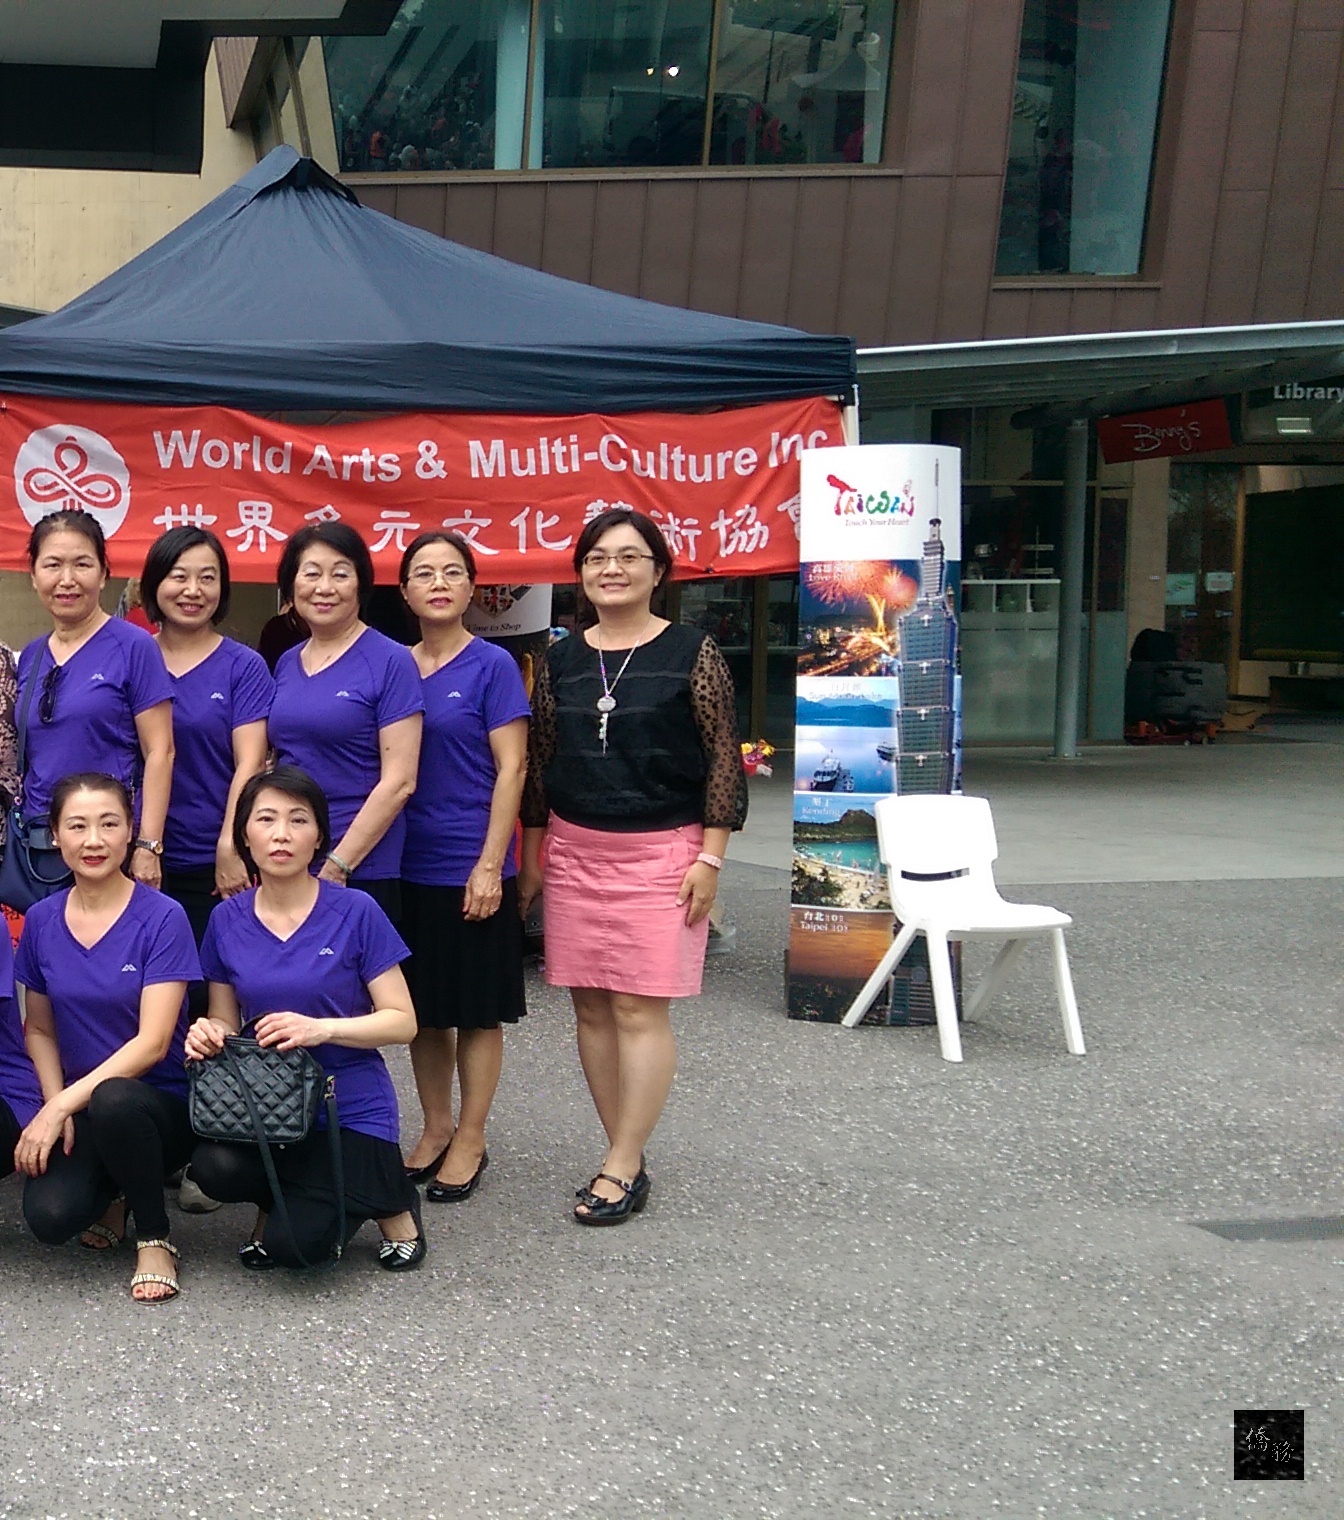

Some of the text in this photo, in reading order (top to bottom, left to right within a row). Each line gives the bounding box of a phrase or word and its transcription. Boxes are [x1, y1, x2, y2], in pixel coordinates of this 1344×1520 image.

[1273, 382, 1344, 404] Library
[153, 430, 293, 474] World
[303, 444, 402, 483] Arts
[415, 439, 448, 479] &
[468, 433, 757, 483] Multi-Culture
[500, 623, 521, 632] Shop
[800, 921, 828, 932] Taipei
